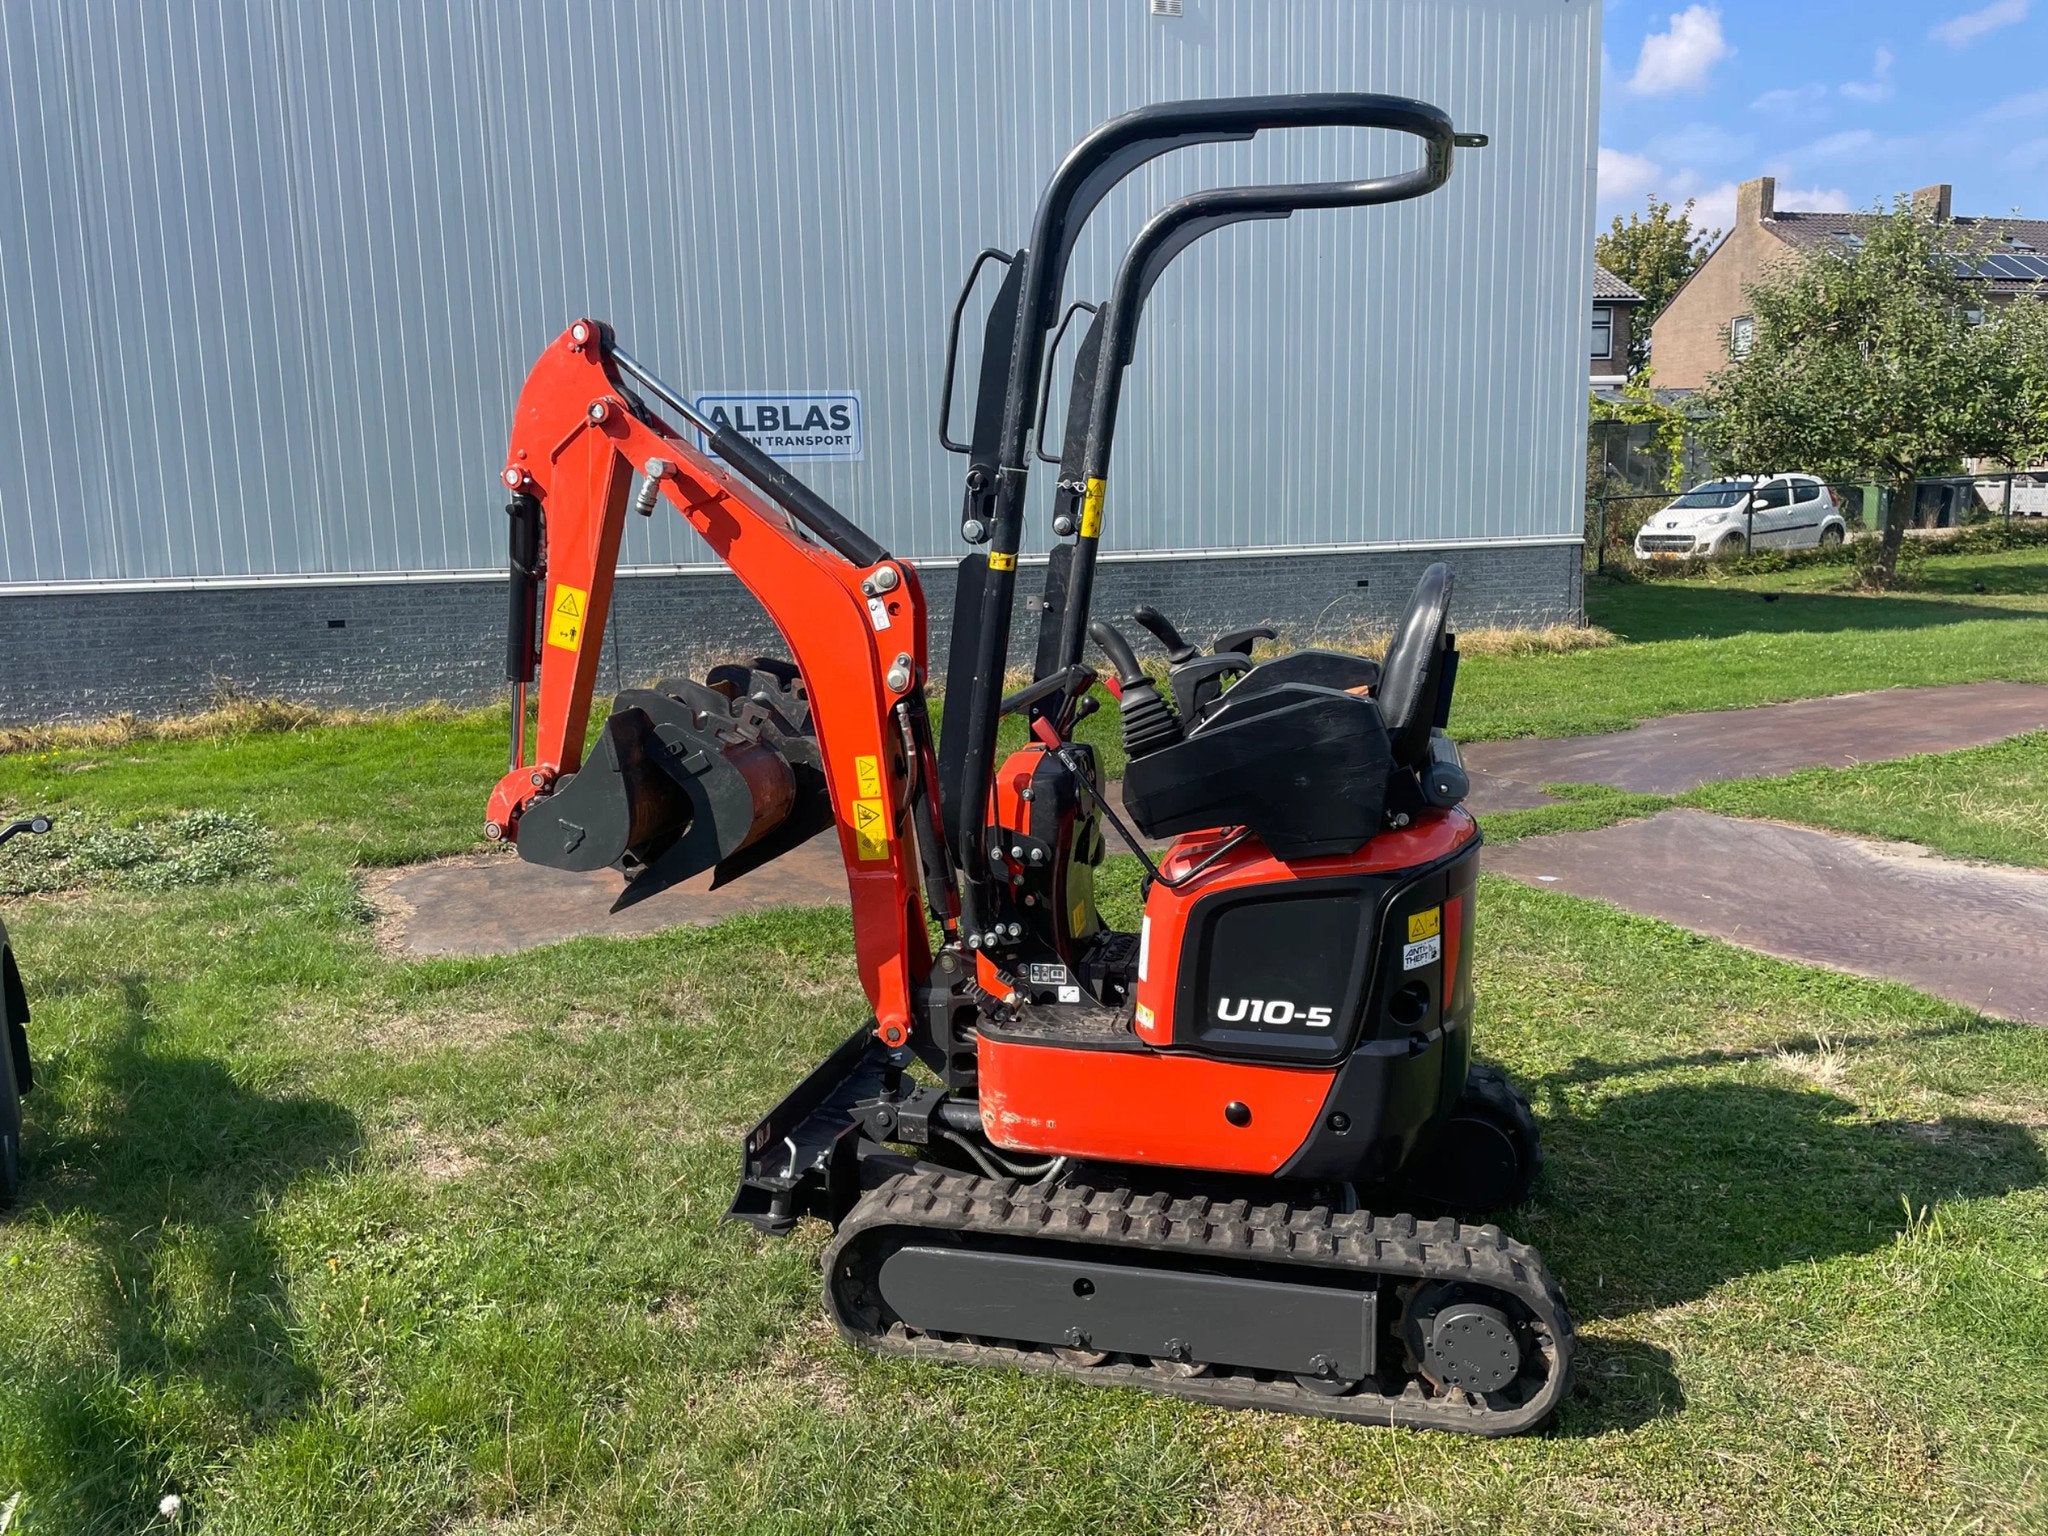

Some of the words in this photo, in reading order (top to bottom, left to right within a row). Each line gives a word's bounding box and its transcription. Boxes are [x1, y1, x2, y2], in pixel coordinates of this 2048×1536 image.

[709, 405, 851, 431] ALBLAS
[766, 435, 852, 446] TRANSPORT
[1405, 952, 1428, 964] THEFT
[1217, 998, 1333, 1027] U10-5
